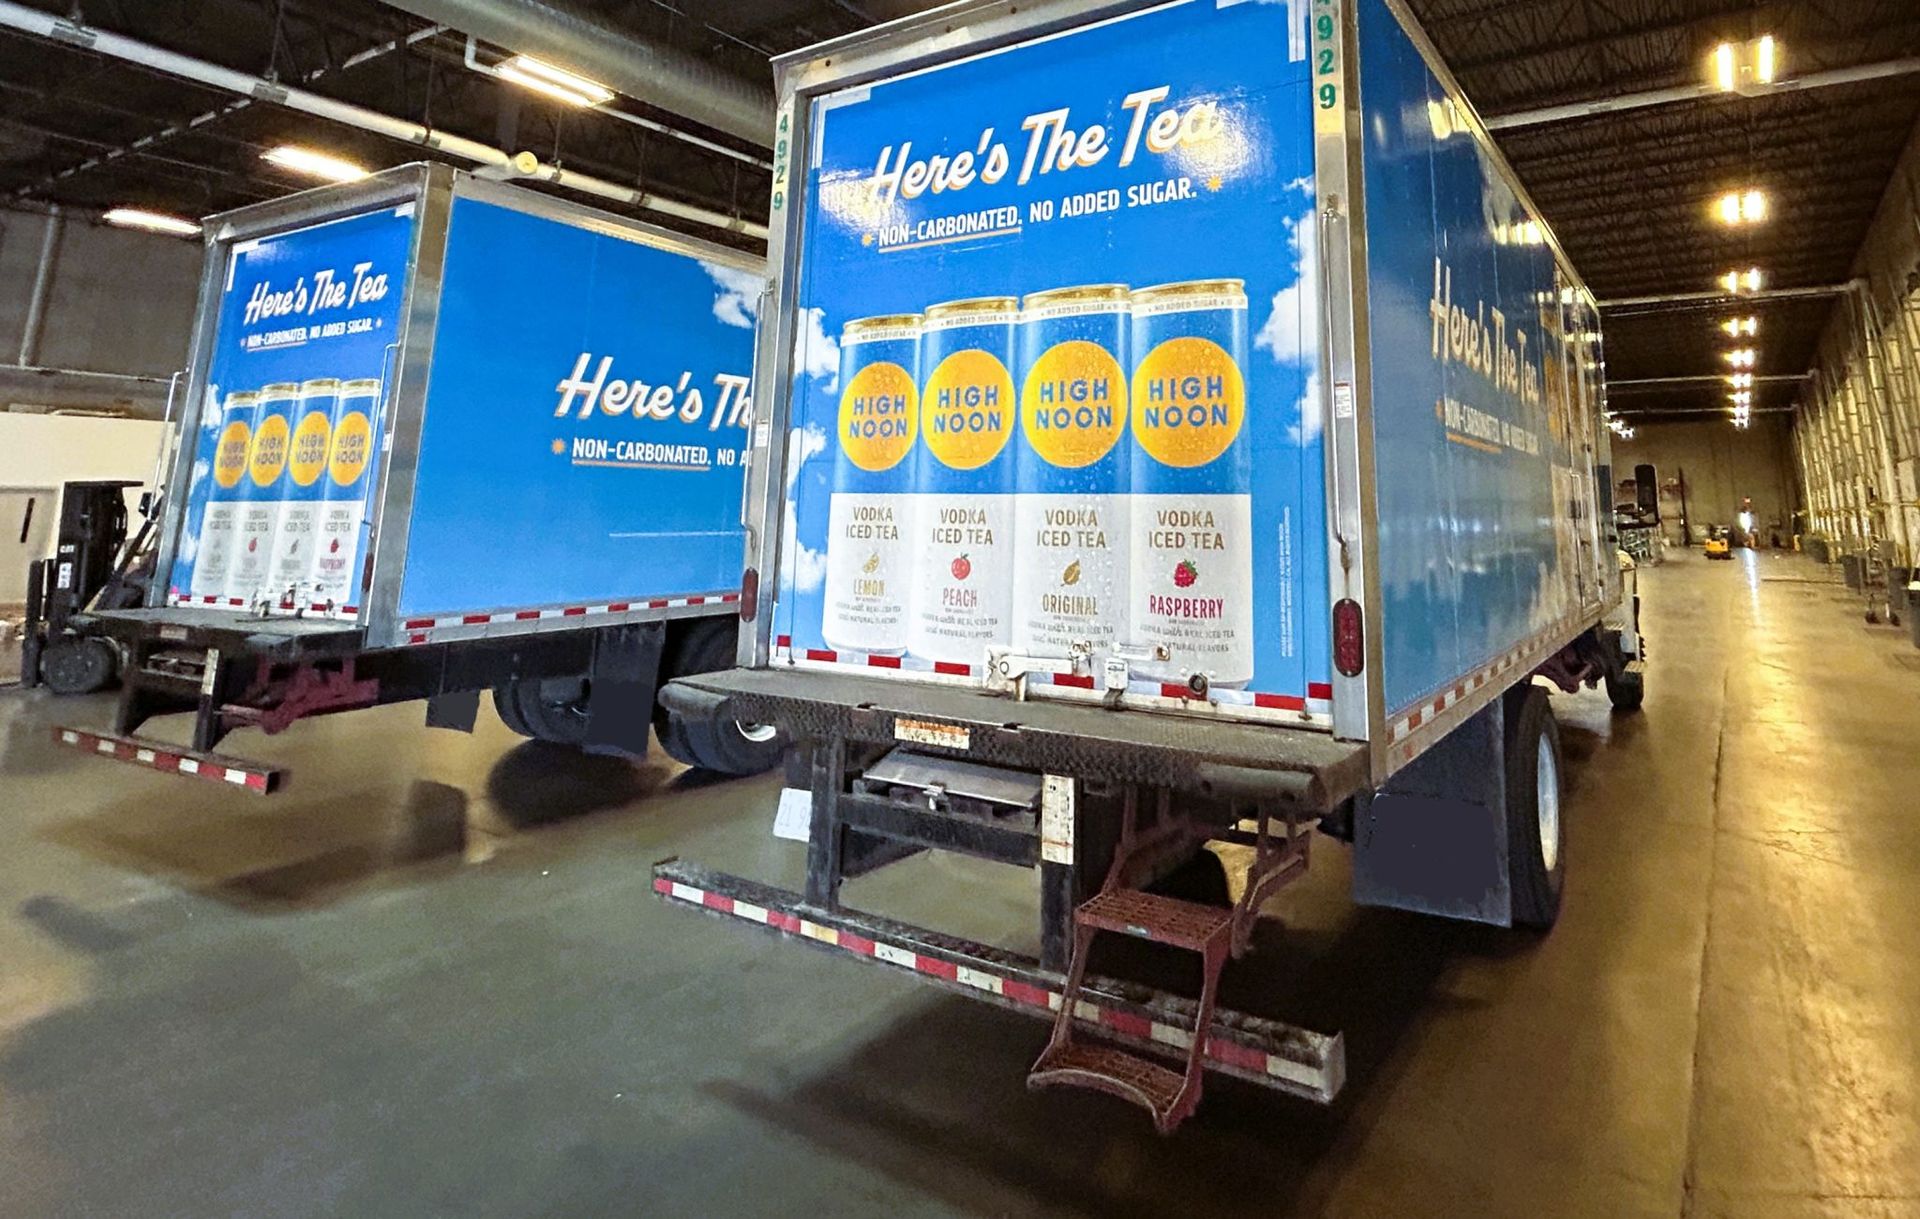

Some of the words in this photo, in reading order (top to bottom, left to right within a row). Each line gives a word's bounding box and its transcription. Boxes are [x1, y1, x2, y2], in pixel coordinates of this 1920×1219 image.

[1317, 0, 1336, 109] 929
[865, 127, 1009, 204] Here's
[1017, 107, 1109, 185] The
[1118, 85, 1223, 168] Tea
[774, 114, 788, 210] 4929
[878, 206, 1022, 247] NON-CARBONATED.
[1029, 201, 1053, 223] NO
[1060, 189, 1120, 218] ADDED
[1127, 177, 1197, 207] SUGAR.
[243, 277, 308, 326] Here's
[308, 269, 346, 315] The
[348, 262, 389, 310] Tea
[1429, 256, 1492, 379] Here's
[310, 325, 320, 339] NO
[322, 321, 346, 338] ADDED
[554, 352, 703, 424] Here's
[709, 373, 755, 432] Th
[938, 385, 998, 408] HIGH
[1040, 378, 1108, 403] HIGH
[1149, 375, 1223, 401] HIGH
[854, 394, 906, 416] HIGH
[1145, 403, 1227, 429] NOON
[849, 418, 907, 439] NOON
[934, 411, 1001, 433] NOON
[1036, 405, 1112, 429] NOON
[572, 437, 712, 466] NON-CARBONATED.
[717, 449, 735, 466] NO
[853, 506, 893, 522] VODKA
[940, 508, 986, 525] VODKA
[1044, 509, 1098, 527] VODKA
[1157, 510, 1215, 528] VODKA
[846, 525, 872, 540] ICED
[876, 525, 899, 541] TEA
[932, 528, 962, 544] ICED
[967, 528, 993, 546] TEA
[1037, 530, 1071, 548] ICED
[1077, 530, 1106, 549] TEA
[1149, 530, 1186, 549] ICED
[1191, 531, 1225, 551] TEA
[853, 578, 885, 597] LEMON
[942, 587, 977, 607] PEACH
[1042, 593, 1099, 616] ORIGINAL
[1149, 595, 1224, 619] RASPBERRY
